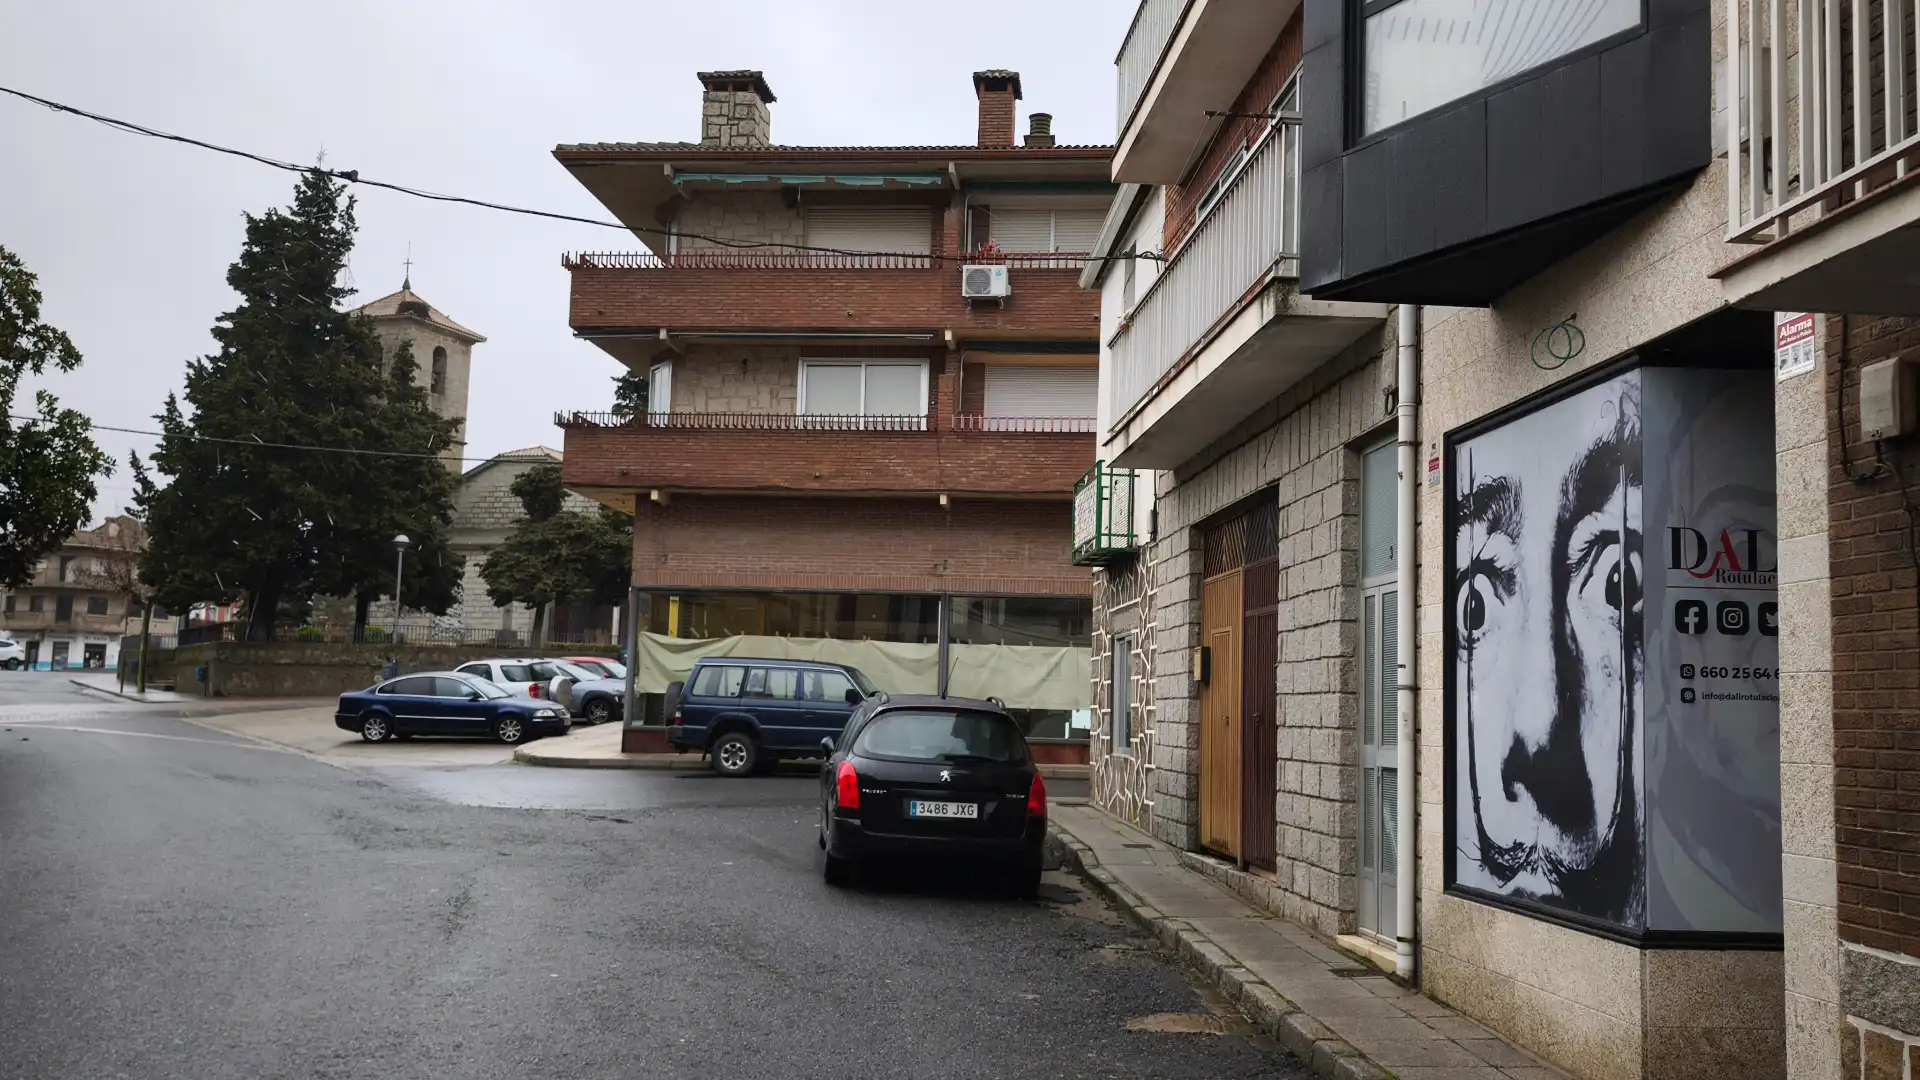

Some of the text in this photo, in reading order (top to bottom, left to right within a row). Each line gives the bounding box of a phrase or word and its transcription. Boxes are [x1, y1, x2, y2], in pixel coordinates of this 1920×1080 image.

[1780, 319, 1812, 338] Alarma
[1715, 568, 1776, 585] Rotulac
[1700, 666, 1728, 679] 660
[1732, 667, 1751, 679] 25
[1753, 667, 1771, 680] 64
[919, 802, 975, 816] 3486 JXG
